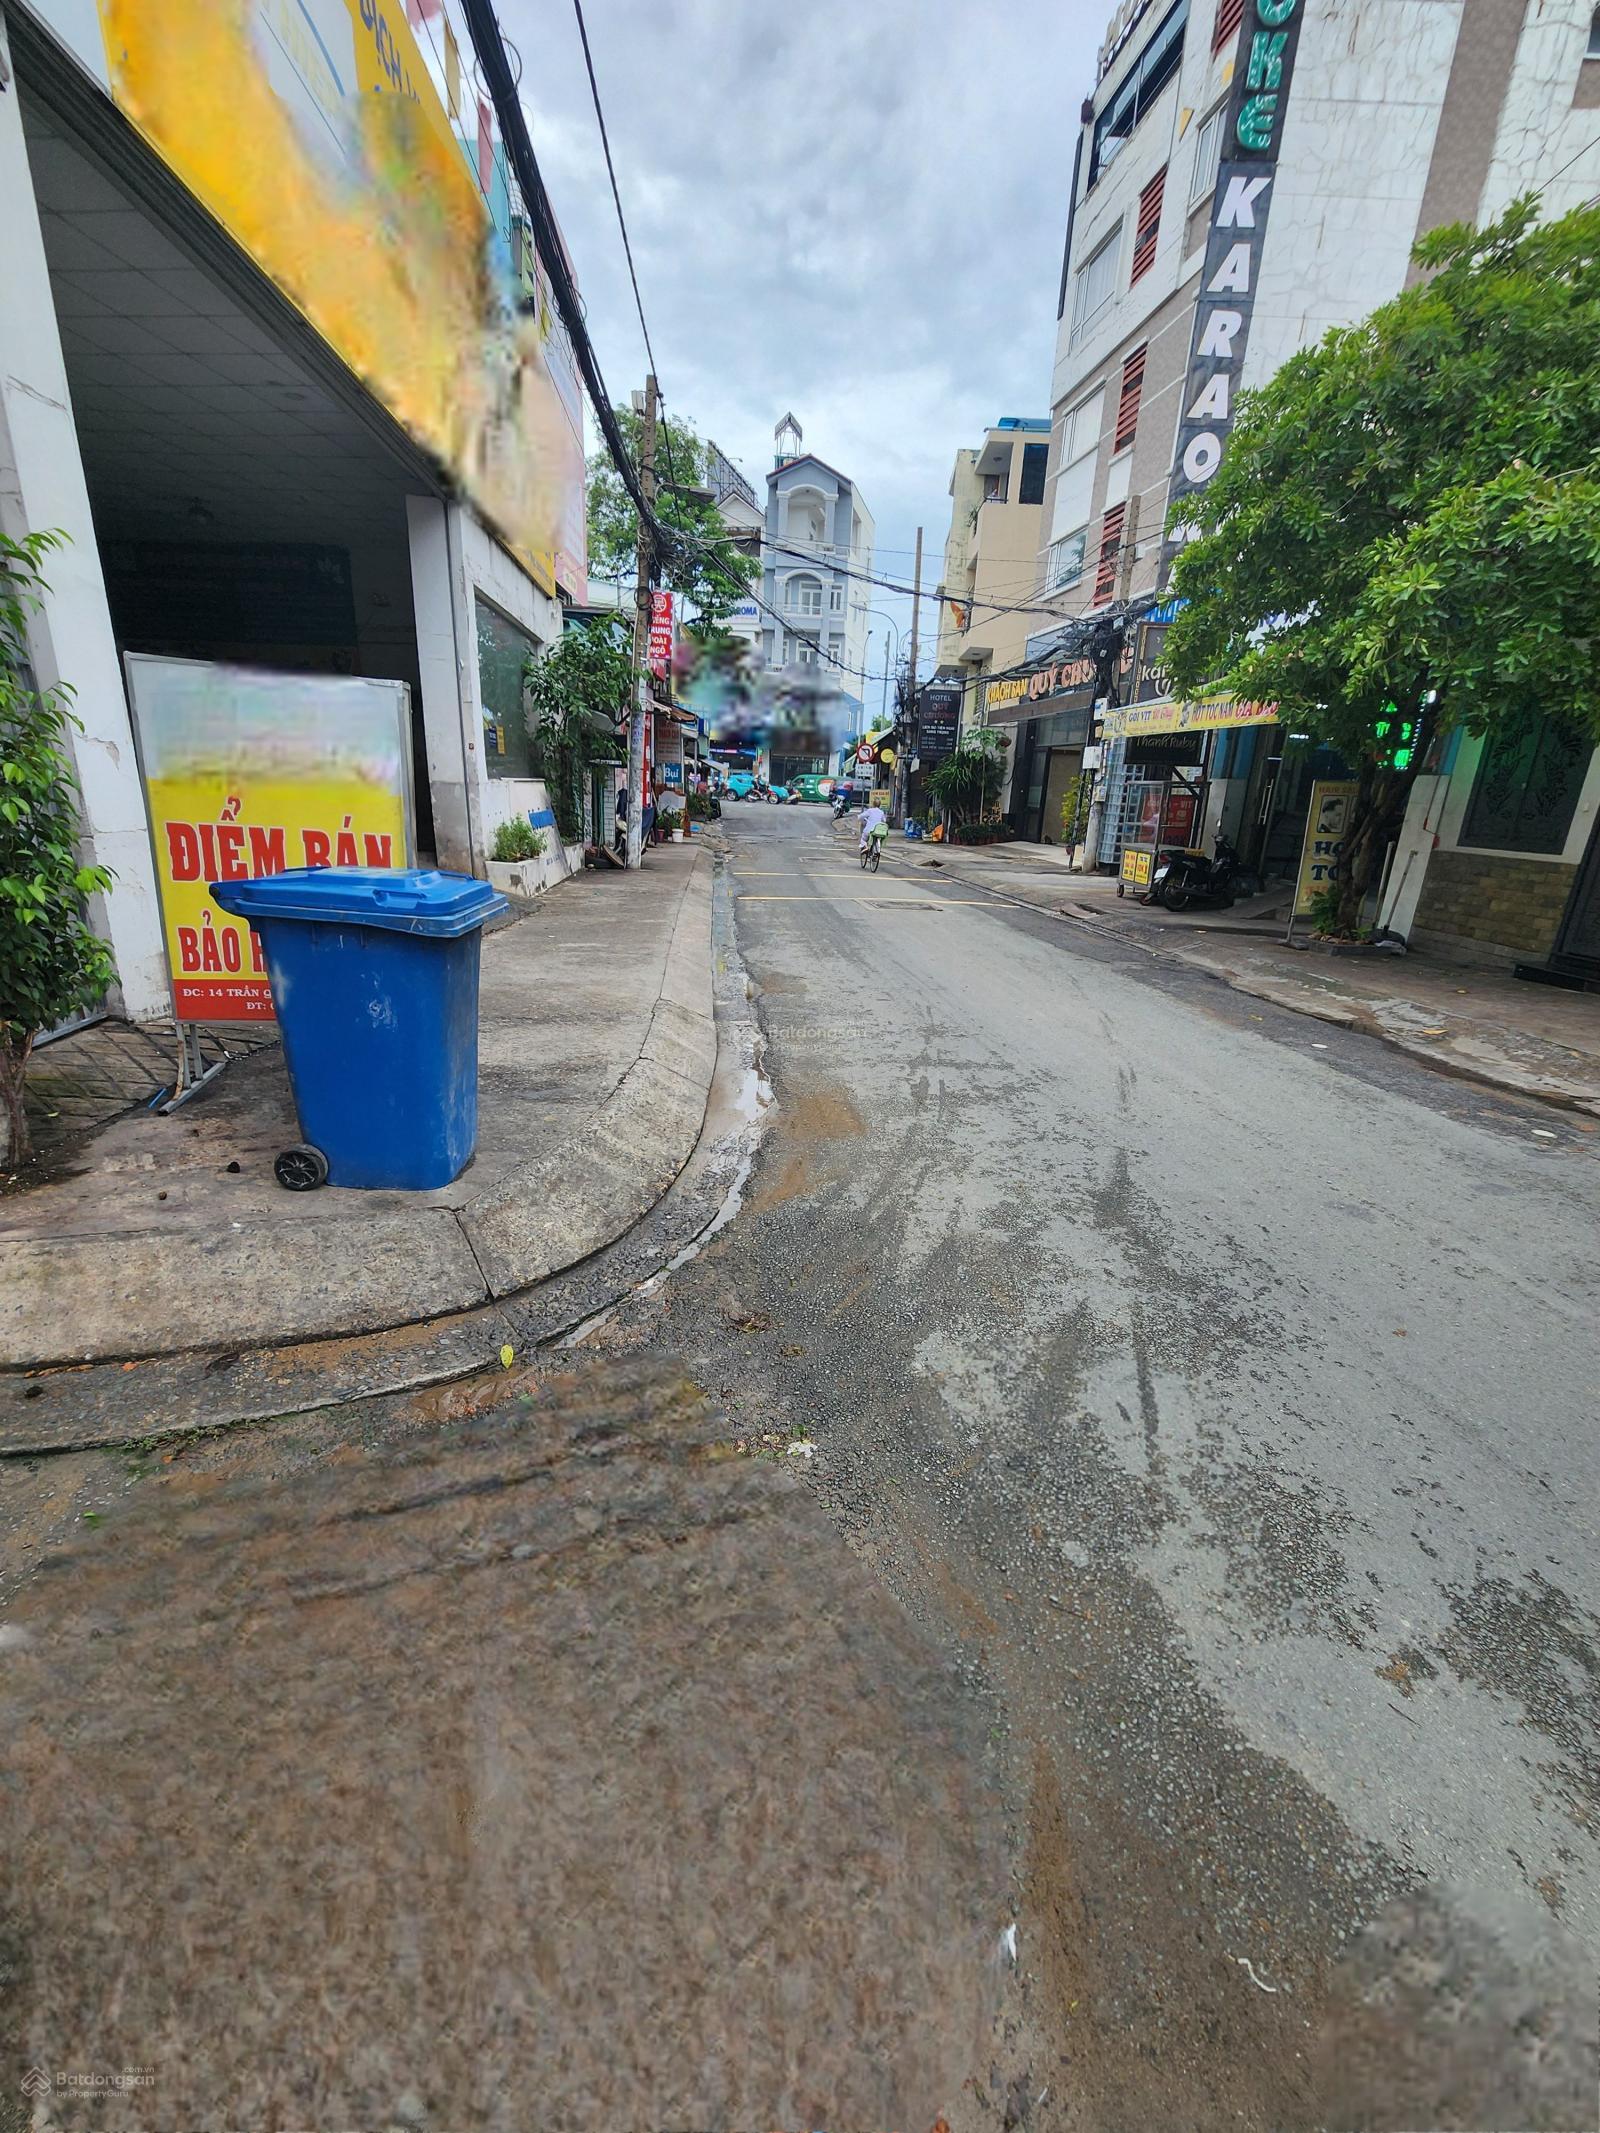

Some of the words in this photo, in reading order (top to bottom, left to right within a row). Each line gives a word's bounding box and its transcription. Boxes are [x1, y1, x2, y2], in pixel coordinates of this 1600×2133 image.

[930, 694, 952, 702] HOTEL
[166, 796, 286, 882] ĐIỂM
[302, 815, 391, 868] BÁN
[178, 910, 242, 972] BẢO
[183, 988, 204, 997] ĐC:
[209, 988, 223, 997] 14
[247, 1002, 266, 1010] ĐT:
